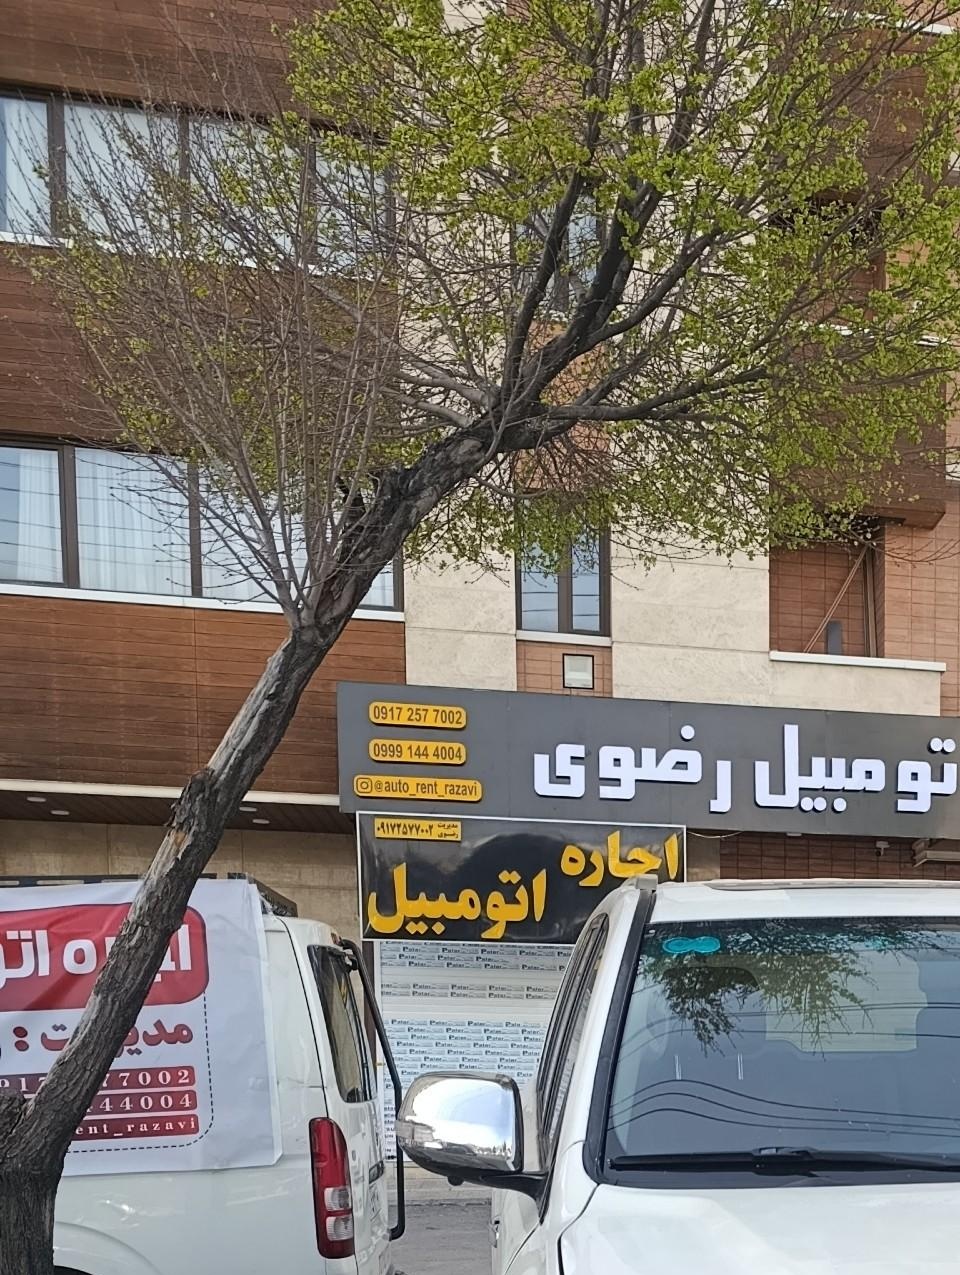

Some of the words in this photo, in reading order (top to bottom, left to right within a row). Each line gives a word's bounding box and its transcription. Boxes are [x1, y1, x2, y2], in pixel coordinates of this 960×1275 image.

[373, 705, 403, 721] 0917
[407, 707, 429, 723] 257
[433, 709, 462, 725] 7002
[373, 742, 403, 758] 0999
[407, 744, 429, 760] 144
[433, 746, 462, 761] 4004
[534, 725, 732, 813] رضوی
[374, 779, 477, 797] @auto_rent_razavi
[560, 830, 679, 887] اجاره
[367, 862, 547, 939] اتومبیل
